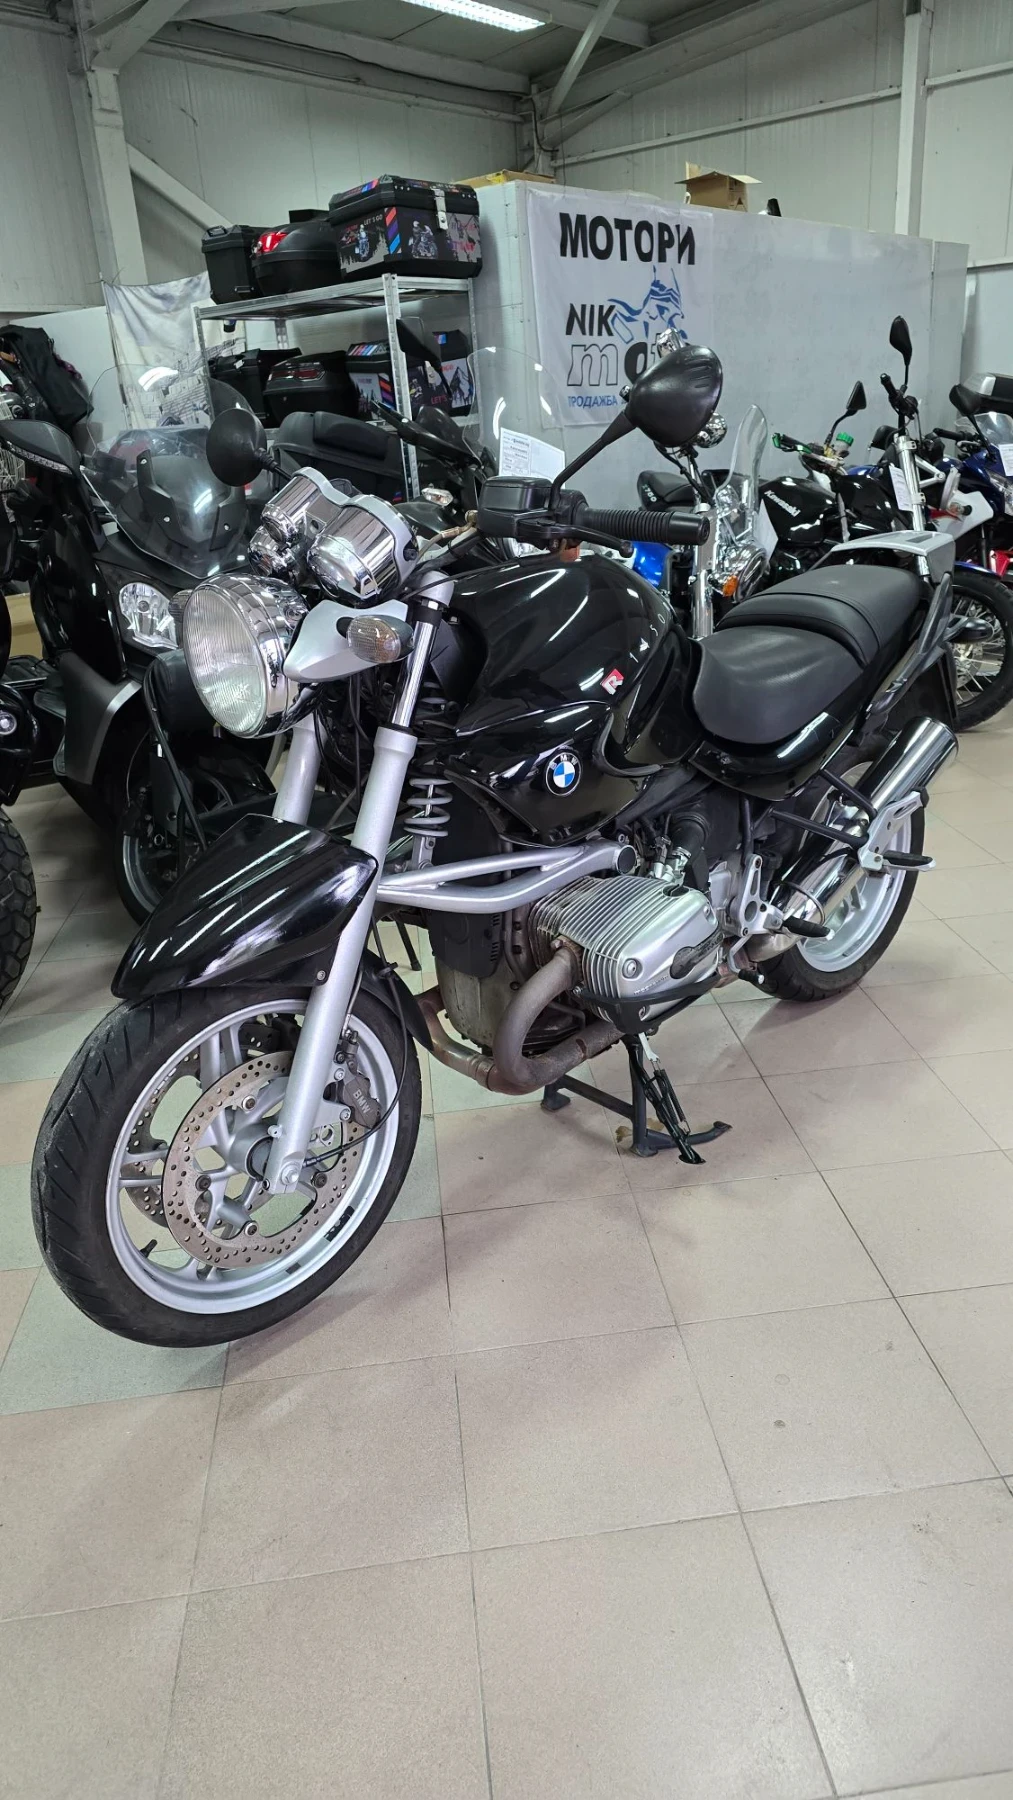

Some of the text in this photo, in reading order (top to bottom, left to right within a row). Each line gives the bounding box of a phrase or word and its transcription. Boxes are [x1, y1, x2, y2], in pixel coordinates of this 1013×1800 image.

[558, 212, 696, 265] МОТОРИ
[565, 303, 616, 336] NIK
[764, 490, 801, 517] Kawasaki
[549, 753, 578, 770] BMW
[353, 1089, 370, 1114] BMW
